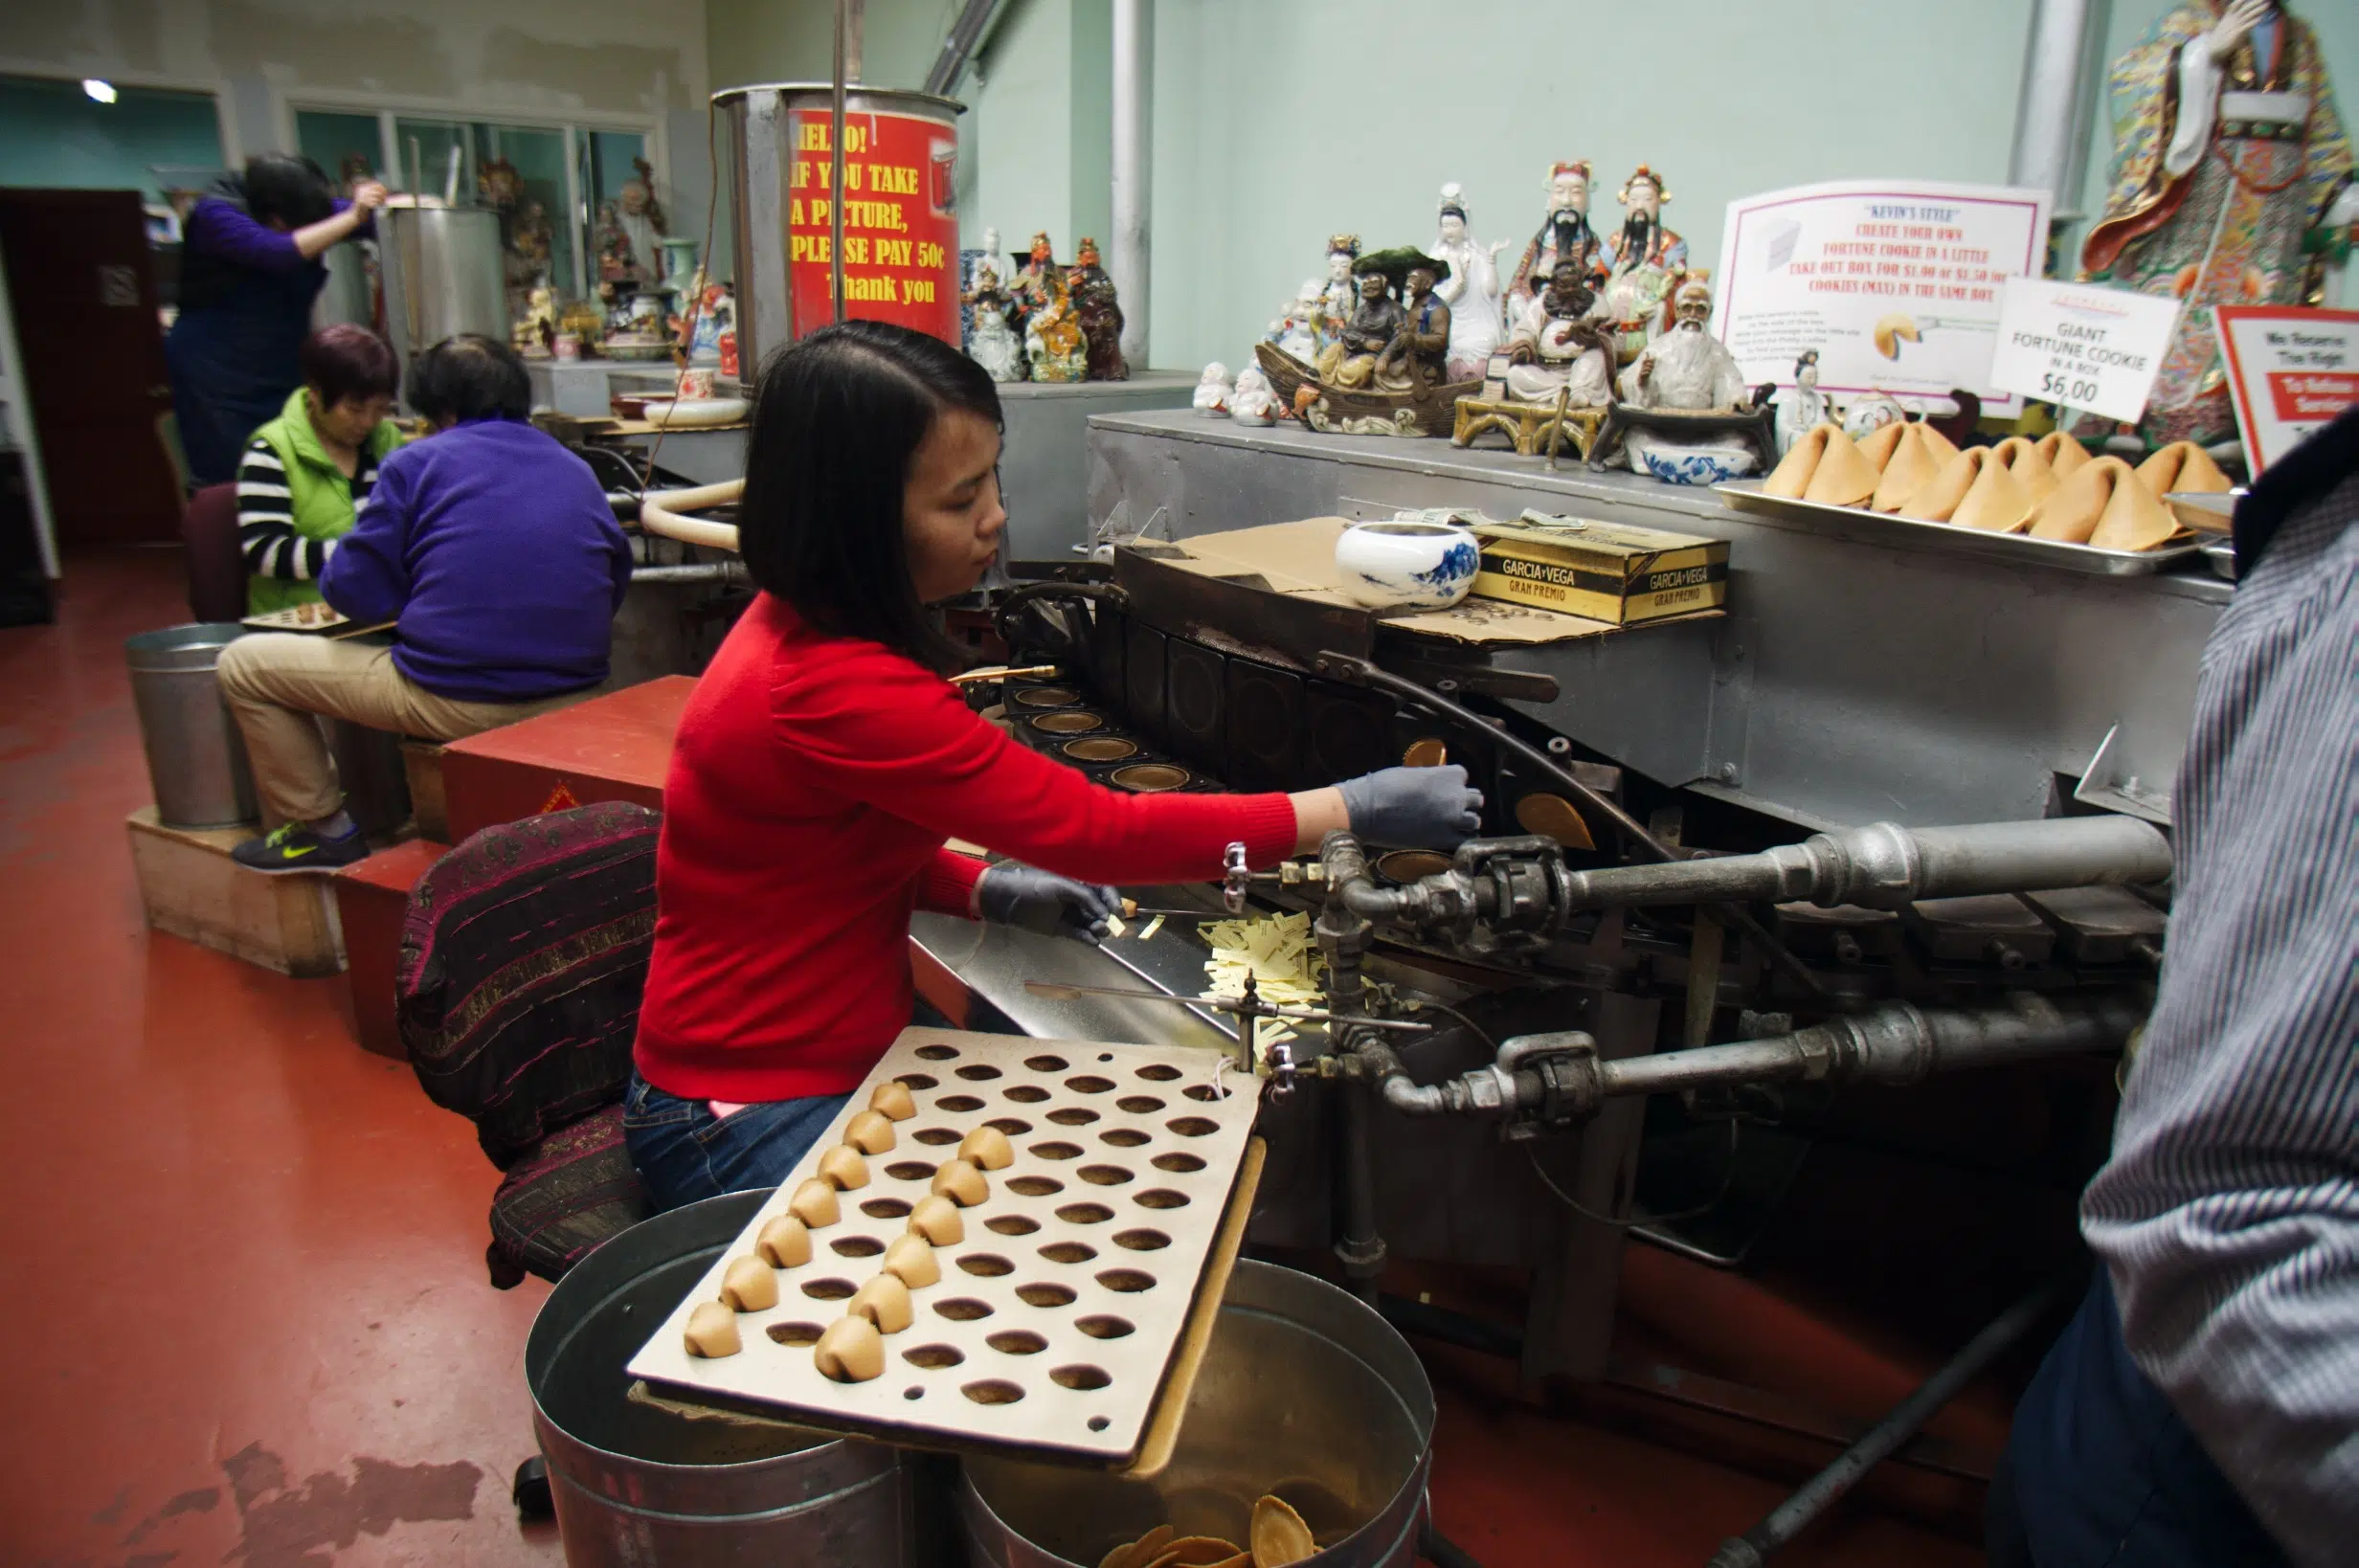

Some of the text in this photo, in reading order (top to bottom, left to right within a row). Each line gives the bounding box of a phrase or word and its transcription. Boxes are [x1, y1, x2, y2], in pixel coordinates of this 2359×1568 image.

[798, 123, 867, 153] ELO!
[791, 162, 810, 188] IF
[868, 164, 919, 195] TAKE
[791, 198, 805, 226] A
[1902, 226, 1933, 239] YOUR
[791, 235, 869, 264] PLESE
[875, 238, 912, 267] PAY
[1823, 242, 1876, 257] FORTUNE
[1879, 244, 1922, 258] COOKIE
[1951, 249, 1990, 263] LITTLE
[1789, 262, 1817, 275] TAKE
[1821, 262, 1844, 275] OUT
[1847, 262, 1873, 276] BOX
[1876, 263, 1899, 277] FOR
[902, 279, 935, 305] you
[1809, 280, 1860, 293] COOKIES
[2056, 323, 2107, 343] GIANT
[2011, 332, 2148, 371] FORTUNE COOKIE
[2050, 356, 2101, 376] IN A BOX
[2040, 372, 2098, 402] $6.00
[1502, 558, 1542, 580] GARCIA
[1545, 565, 1575, 586] VEGA
[1650, 572, 1682, 591] GARCIA
[1685, 567, 1707, 584] VEGA
[1509, 580, 1565, 602] GRAN PREMIO
[1654, 588, 1700, 607] GRAN PREMIO
